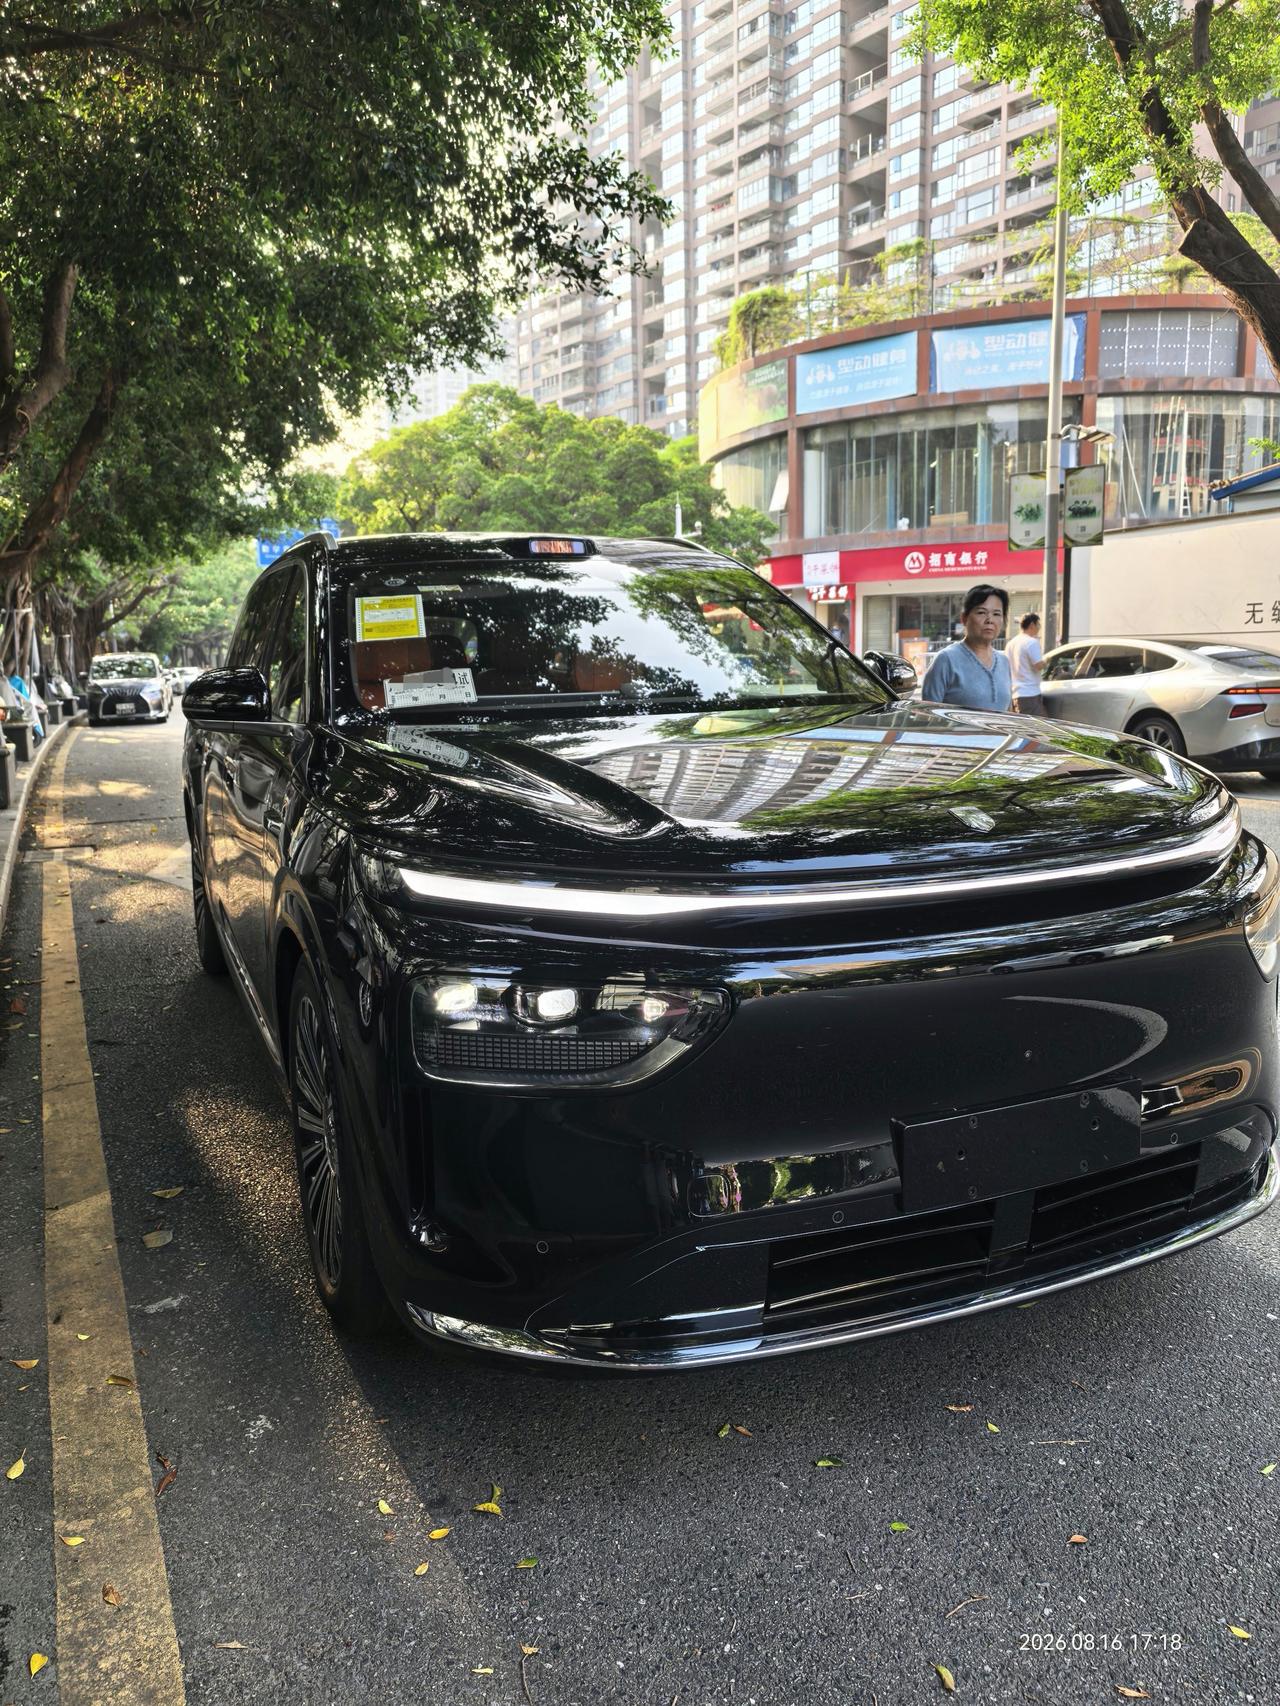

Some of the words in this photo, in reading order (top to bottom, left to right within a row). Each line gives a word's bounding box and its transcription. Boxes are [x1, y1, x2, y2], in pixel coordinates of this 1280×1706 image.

[984, 331, 1050, 352] 型动健
[928, 550, 989, 567] 招商银行
[458, 672, 470, 686] 试
